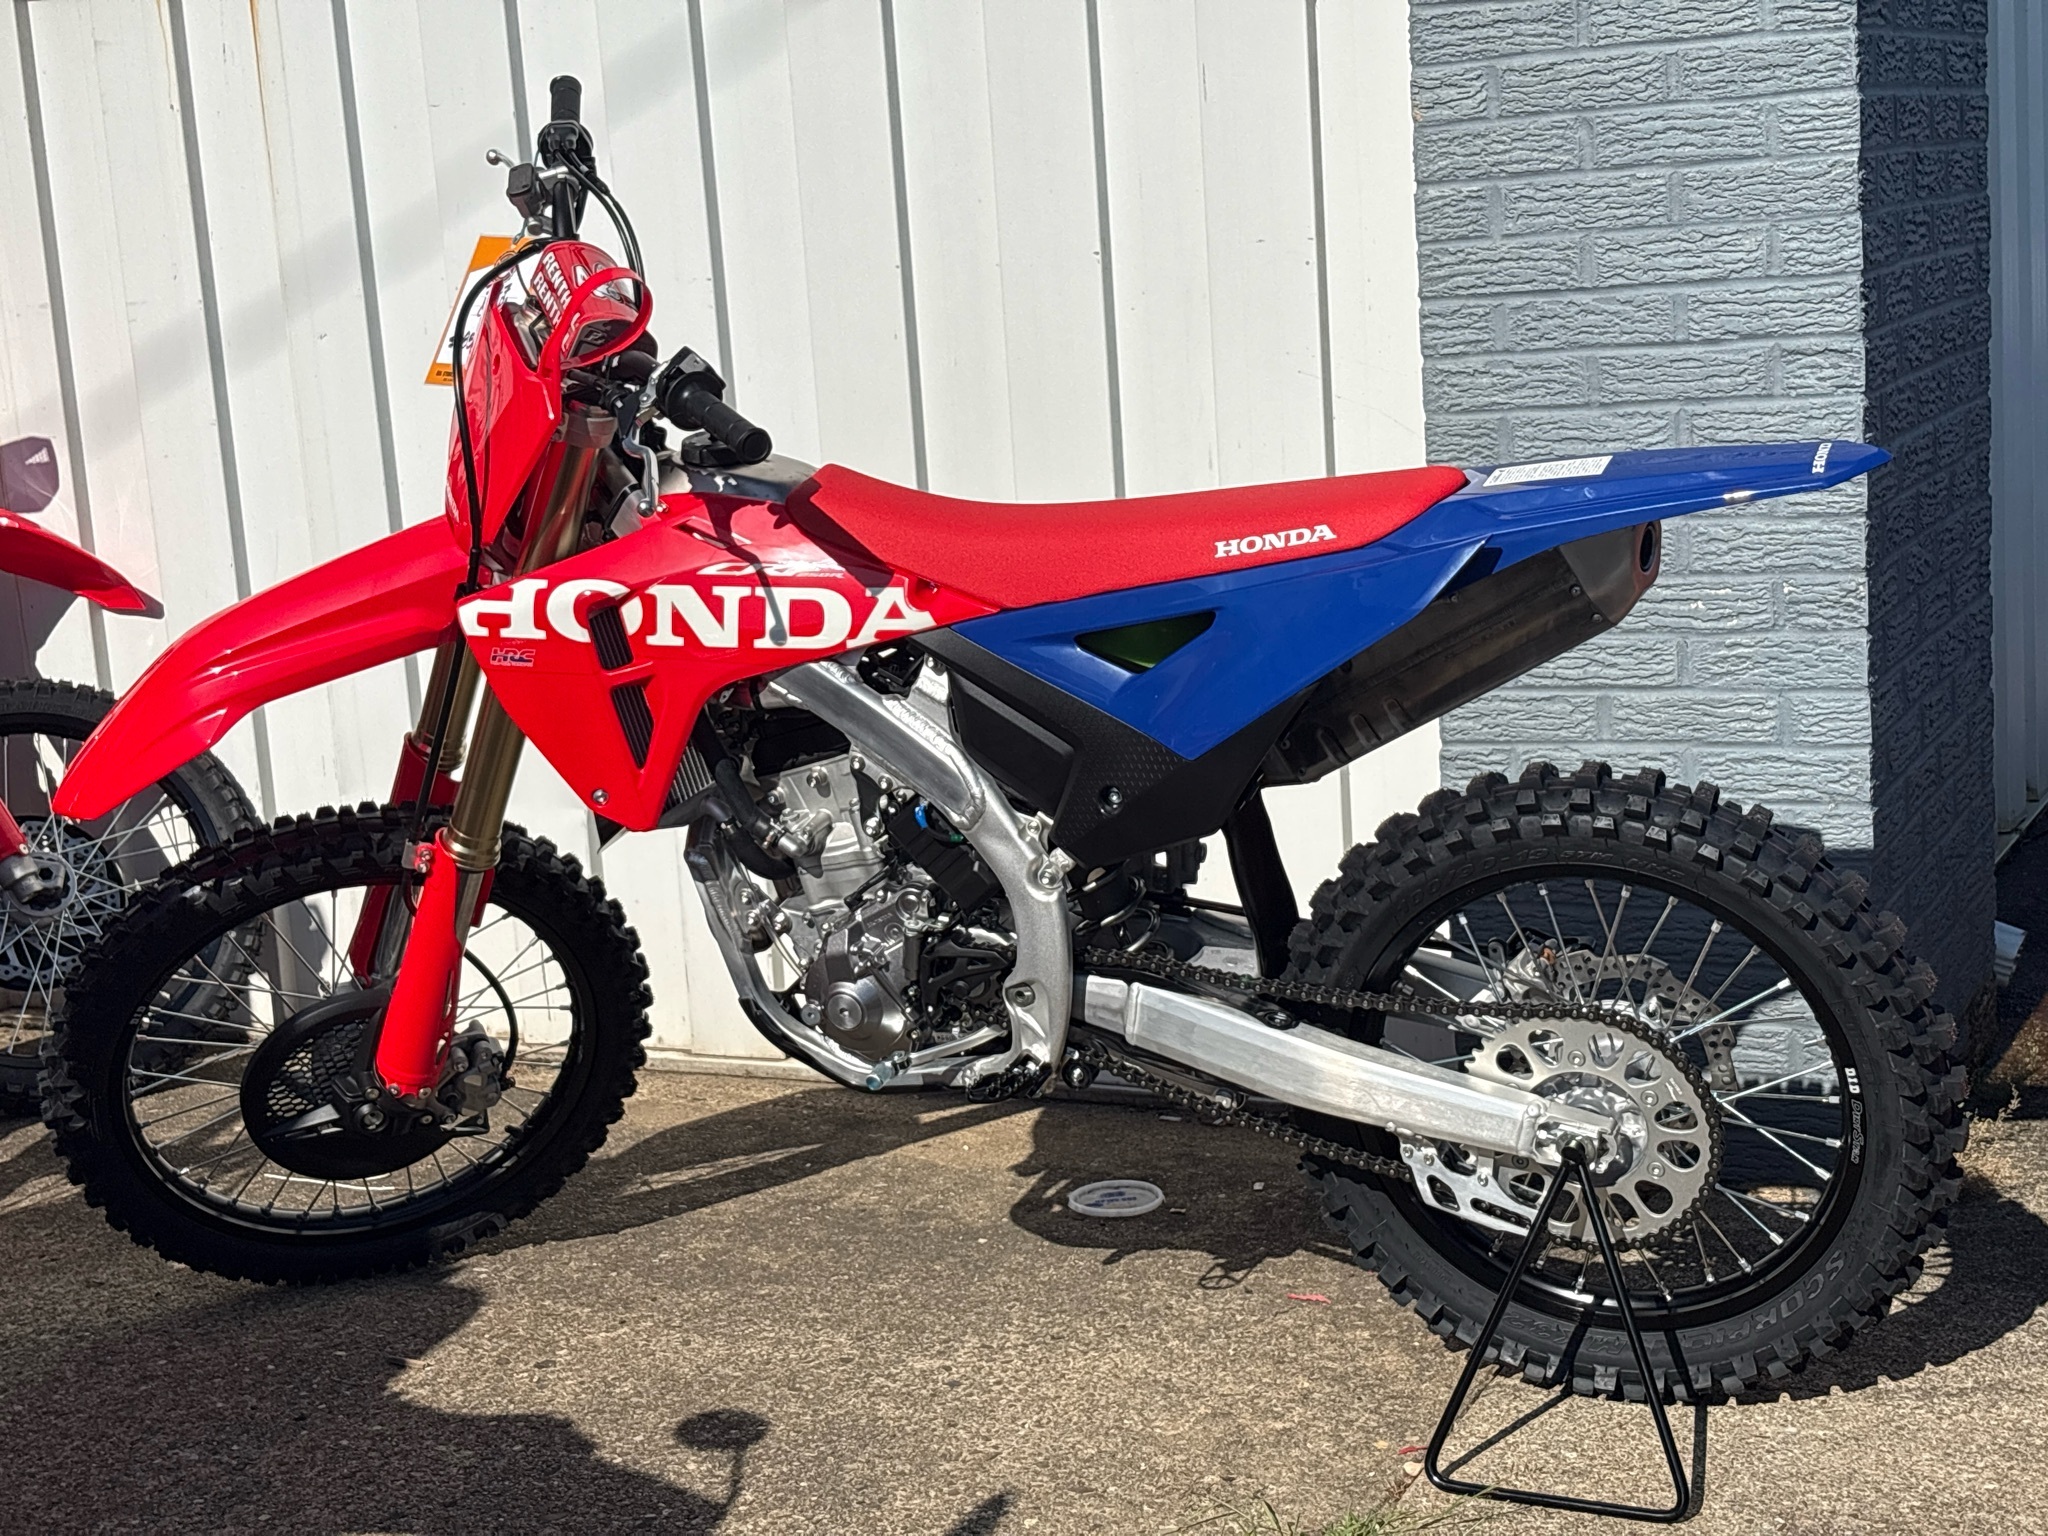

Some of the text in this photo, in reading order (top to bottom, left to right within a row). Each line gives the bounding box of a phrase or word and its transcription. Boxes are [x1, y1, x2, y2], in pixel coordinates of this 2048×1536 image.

[533, 271, 570, 353] RENTHL
[542, 251, 581, 332] RENTHL
[1811, 442, 1833, 474] HOND
[1214, 524, 1337, 558] HONDA
[458, 576, 937, 650] HONDA
[489, 647, 536, 664] HRC
